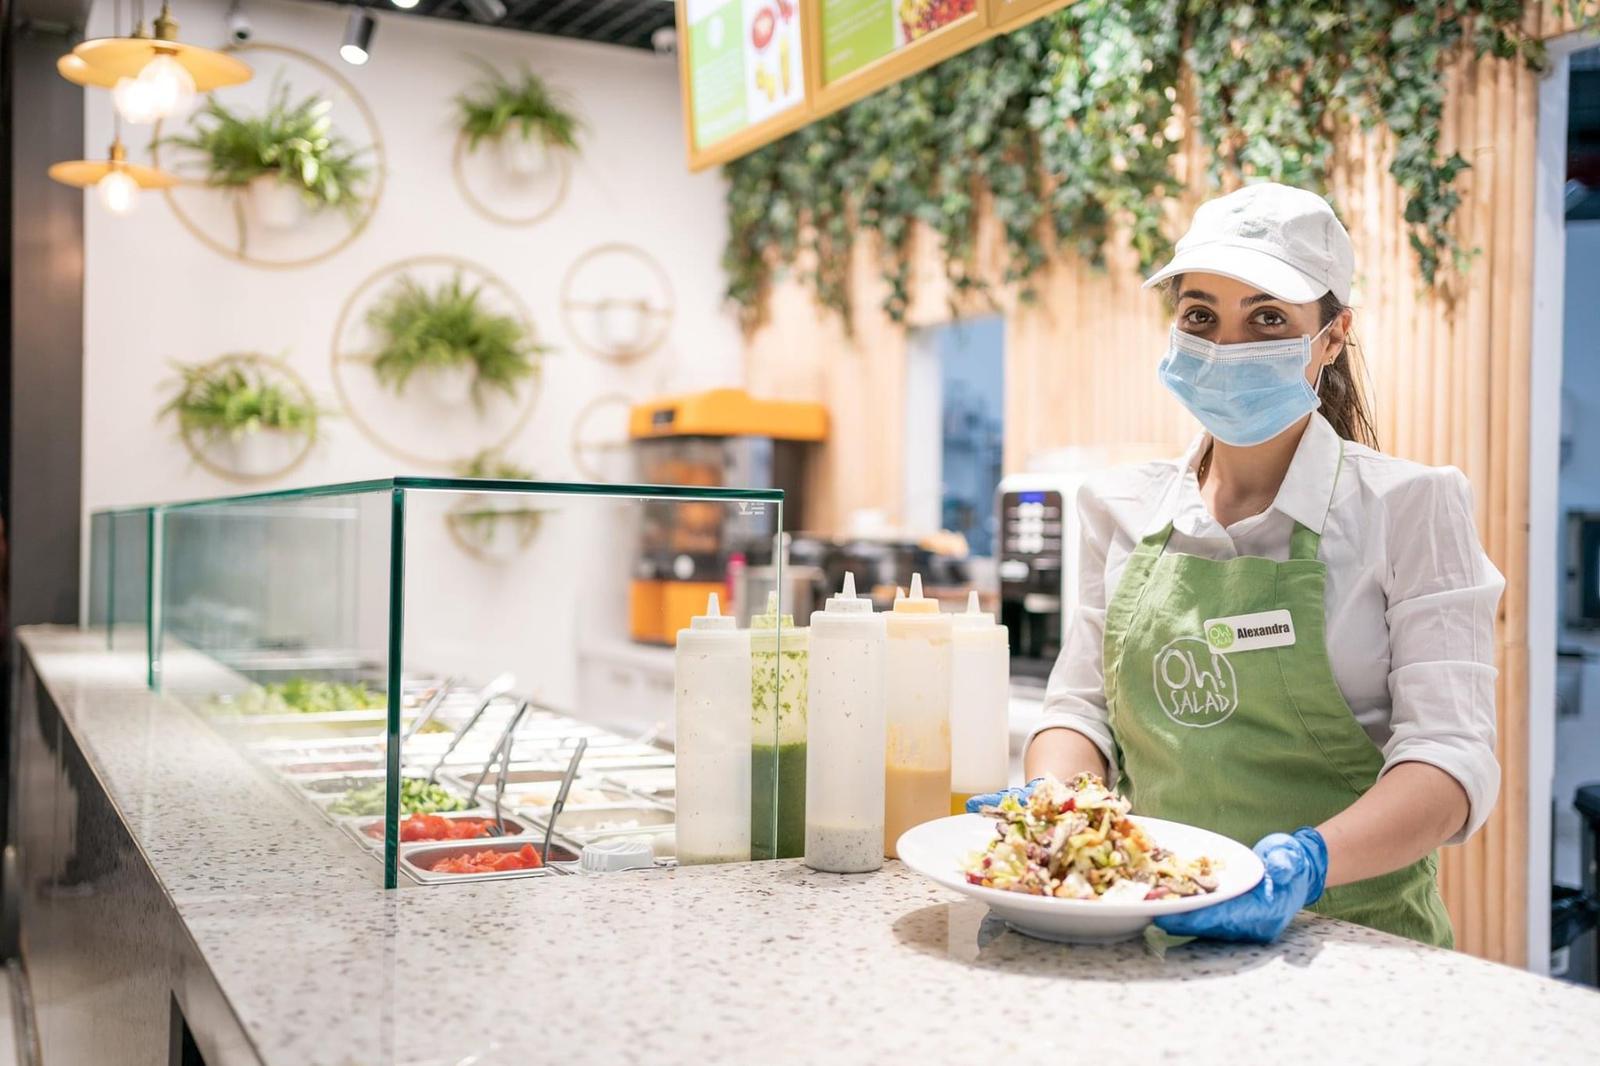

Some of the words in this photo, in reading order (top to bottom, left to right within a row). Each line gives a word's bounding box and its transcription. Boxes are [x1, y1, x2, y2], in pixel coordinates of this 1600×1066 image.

[1237, 623, 1290, 639] Alexandra
[1161, 648, 1226, 693] Oh!
[1170, 690, 1230, 715] SALAD
